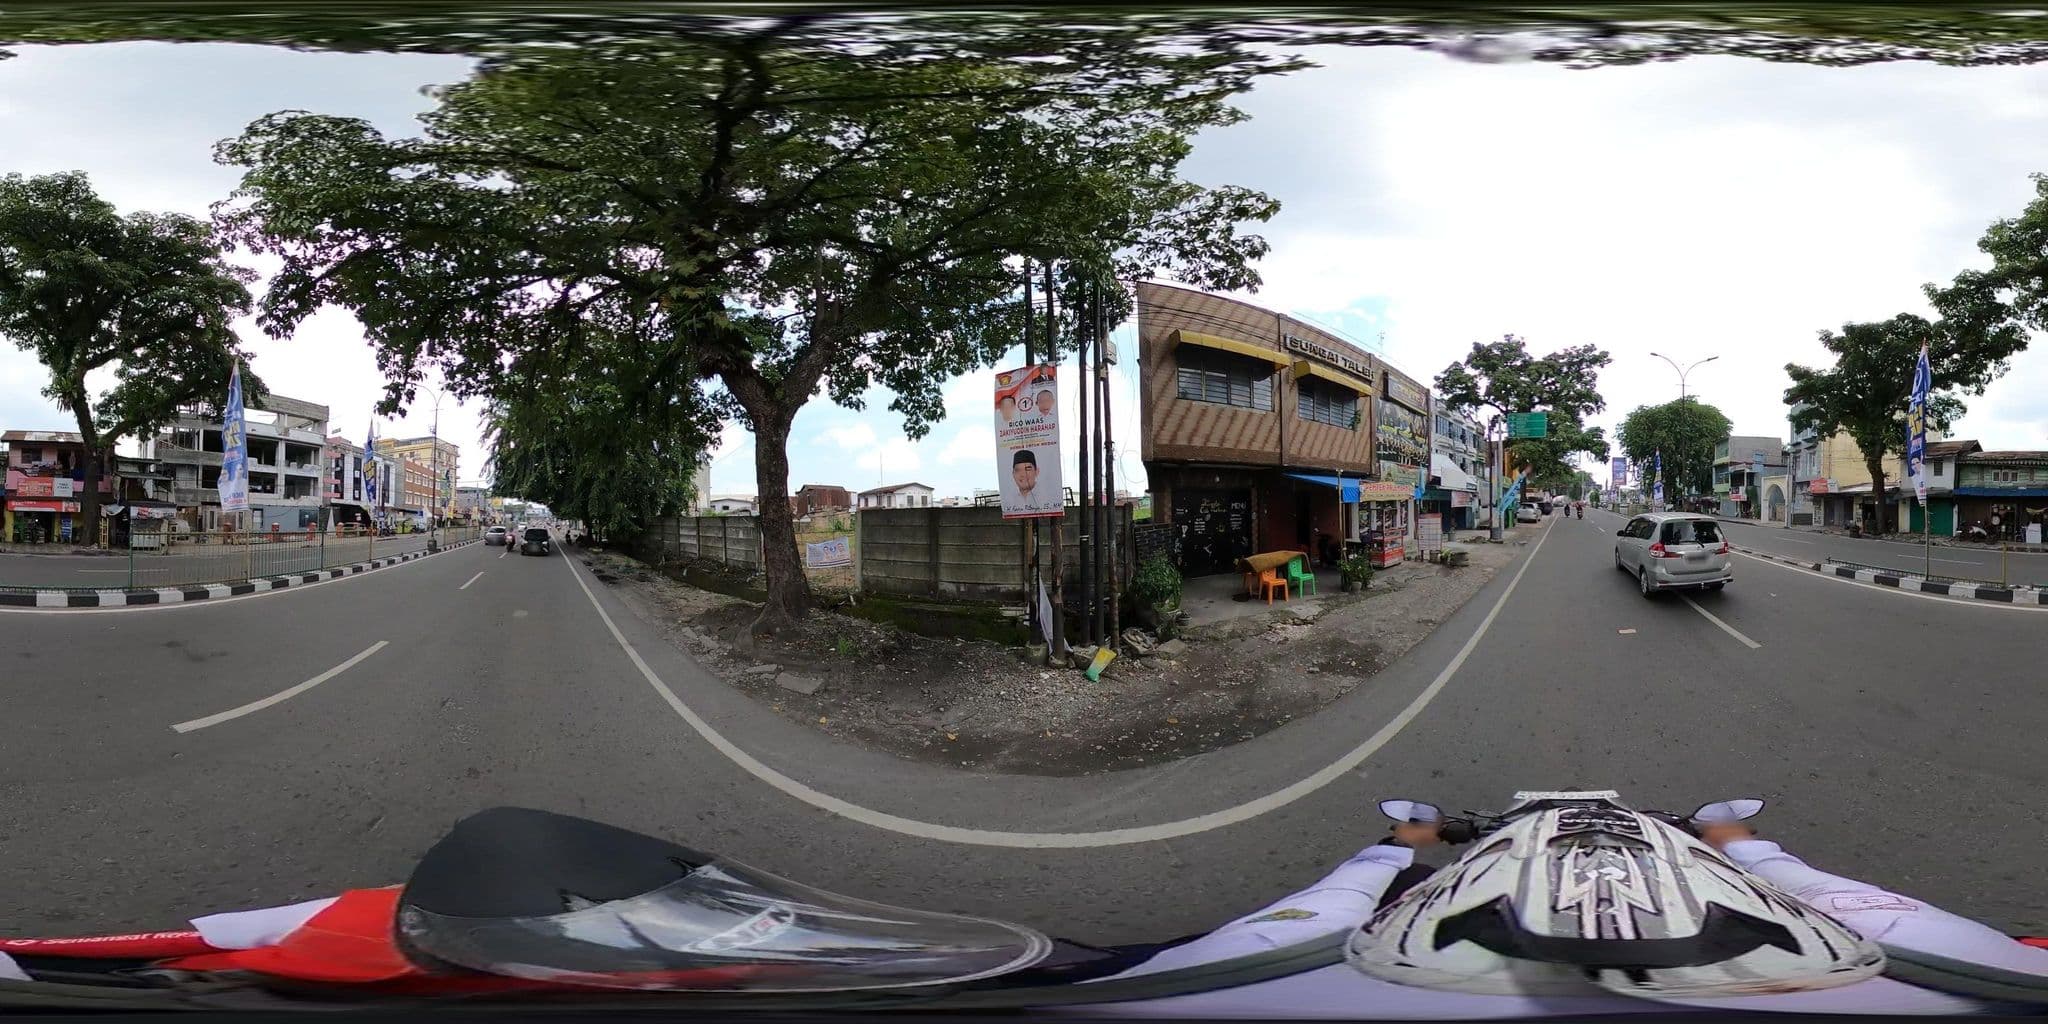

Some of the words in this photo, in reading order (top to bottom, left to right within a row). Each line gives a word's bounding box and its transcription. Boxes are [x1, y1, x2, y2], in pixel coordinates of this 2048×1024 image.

[1289, 336, 1339, 364] SUNGAI
[1009, 420, 1023, 428] RICO
[1025, 418, 1044, 426] WAAS
[1030, 423, 1056, 433] HARAHAP
[1560, 818, 1638, 826] HONDA
